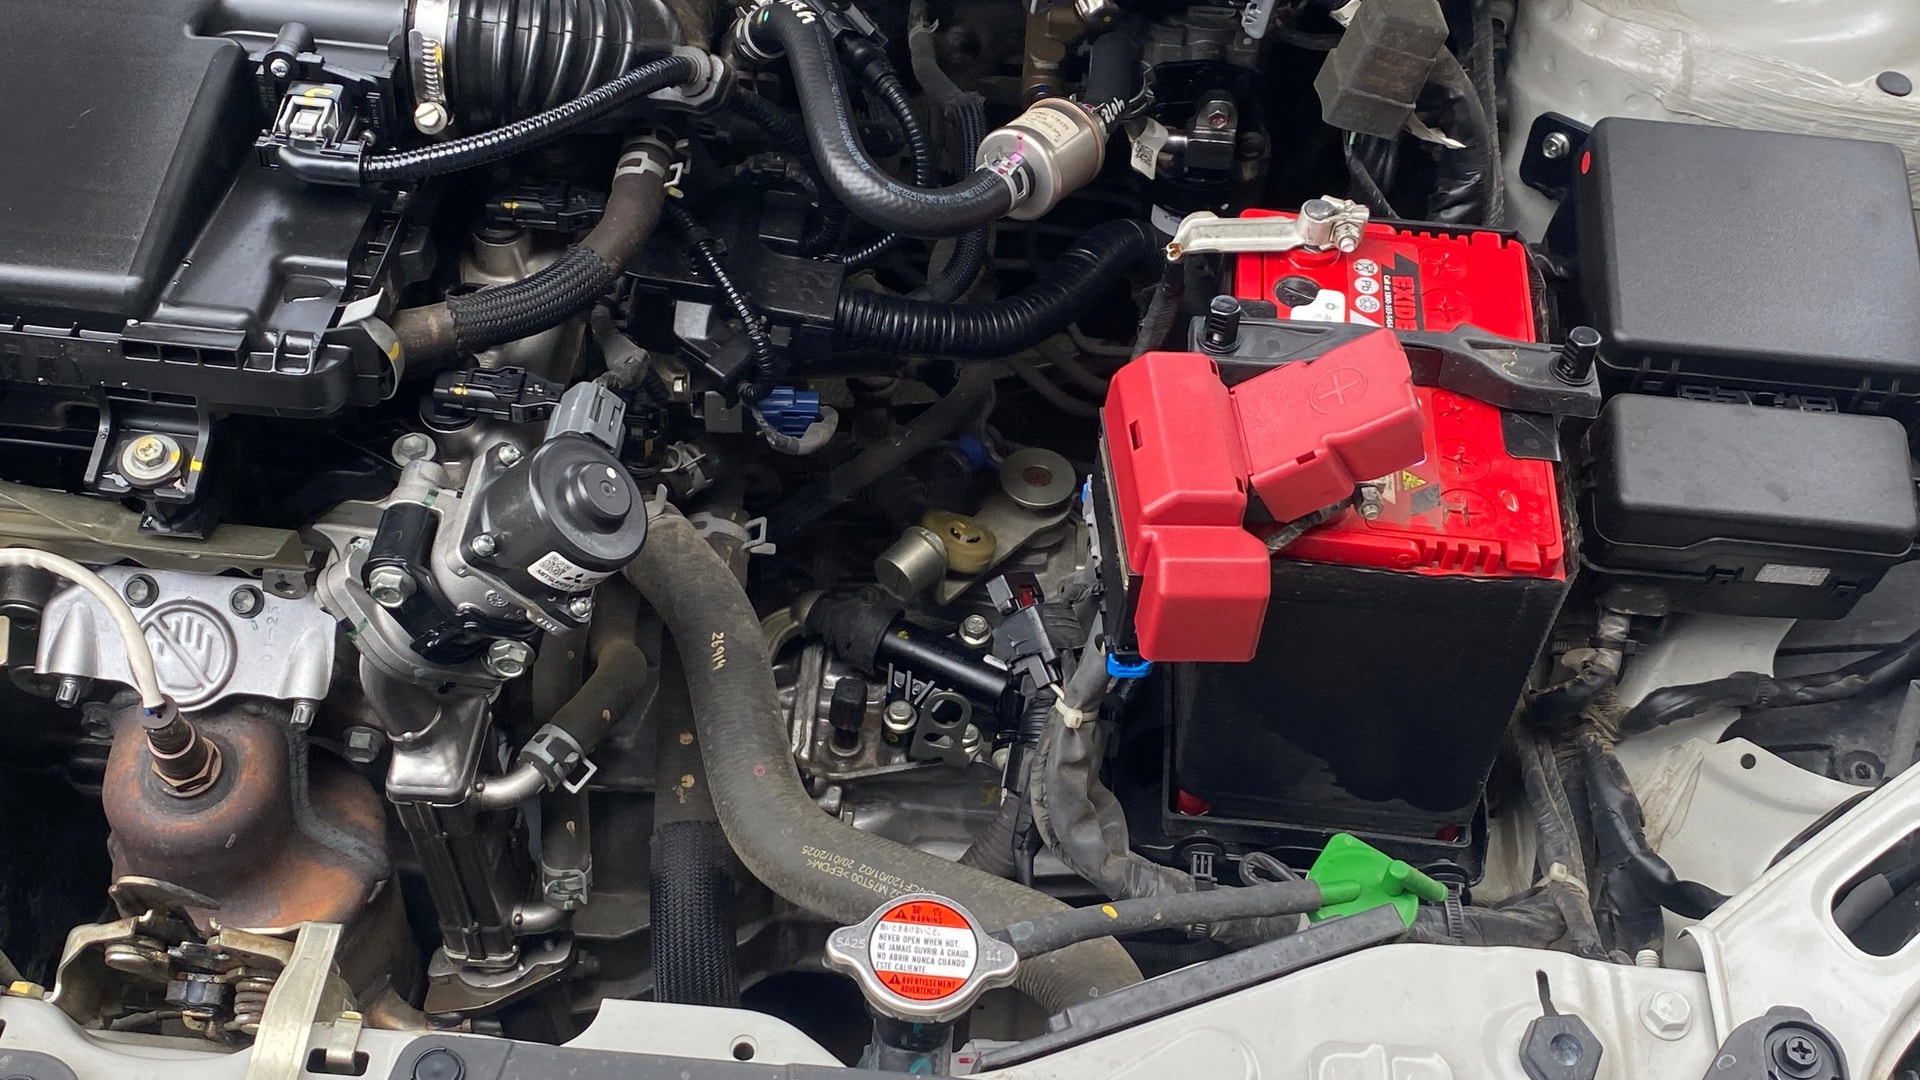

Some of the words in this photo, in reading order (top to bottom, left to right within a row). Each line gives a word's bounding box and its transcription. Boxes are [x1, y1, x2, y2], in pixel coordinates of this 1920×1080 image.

[1360, 279, 1372, 292] Pb
[1392, 276, 1417, 331] EXIDE
[711, 631, 726, 670] 26914
[800, 845, 856, 869] 20/01/2025
[850, 872, 890, 897] M75T00
[911, 915, 942, 925] WARNING
[878, 932, 901, 944] NEVER
[902, 935, 921, 945] OPEN
[923, 936, 944, 946] WHEN
[945, 938, 960, 948] HOT.
[877, 942, 887, 951] NE
[888, 943, 912, 954] JAMAIS
[913, 946, 938, 956] OUVRIR
[946, 948, 970, 959] CHAUD.
[875, 961, 892, 971] ESTE
[894, 962, 928, 974] CALIENTE.
[876, 951, 887, 961] NO
[888, 953, 910, 963] ABRIR
[911, 955, 935, 966] NUNCA
[937, 957, 966, 968] CUANDO
[900, 984, 941, 996] ADVERTENCIA
[901, 975, 956, 990] AVERTISSEMENT
